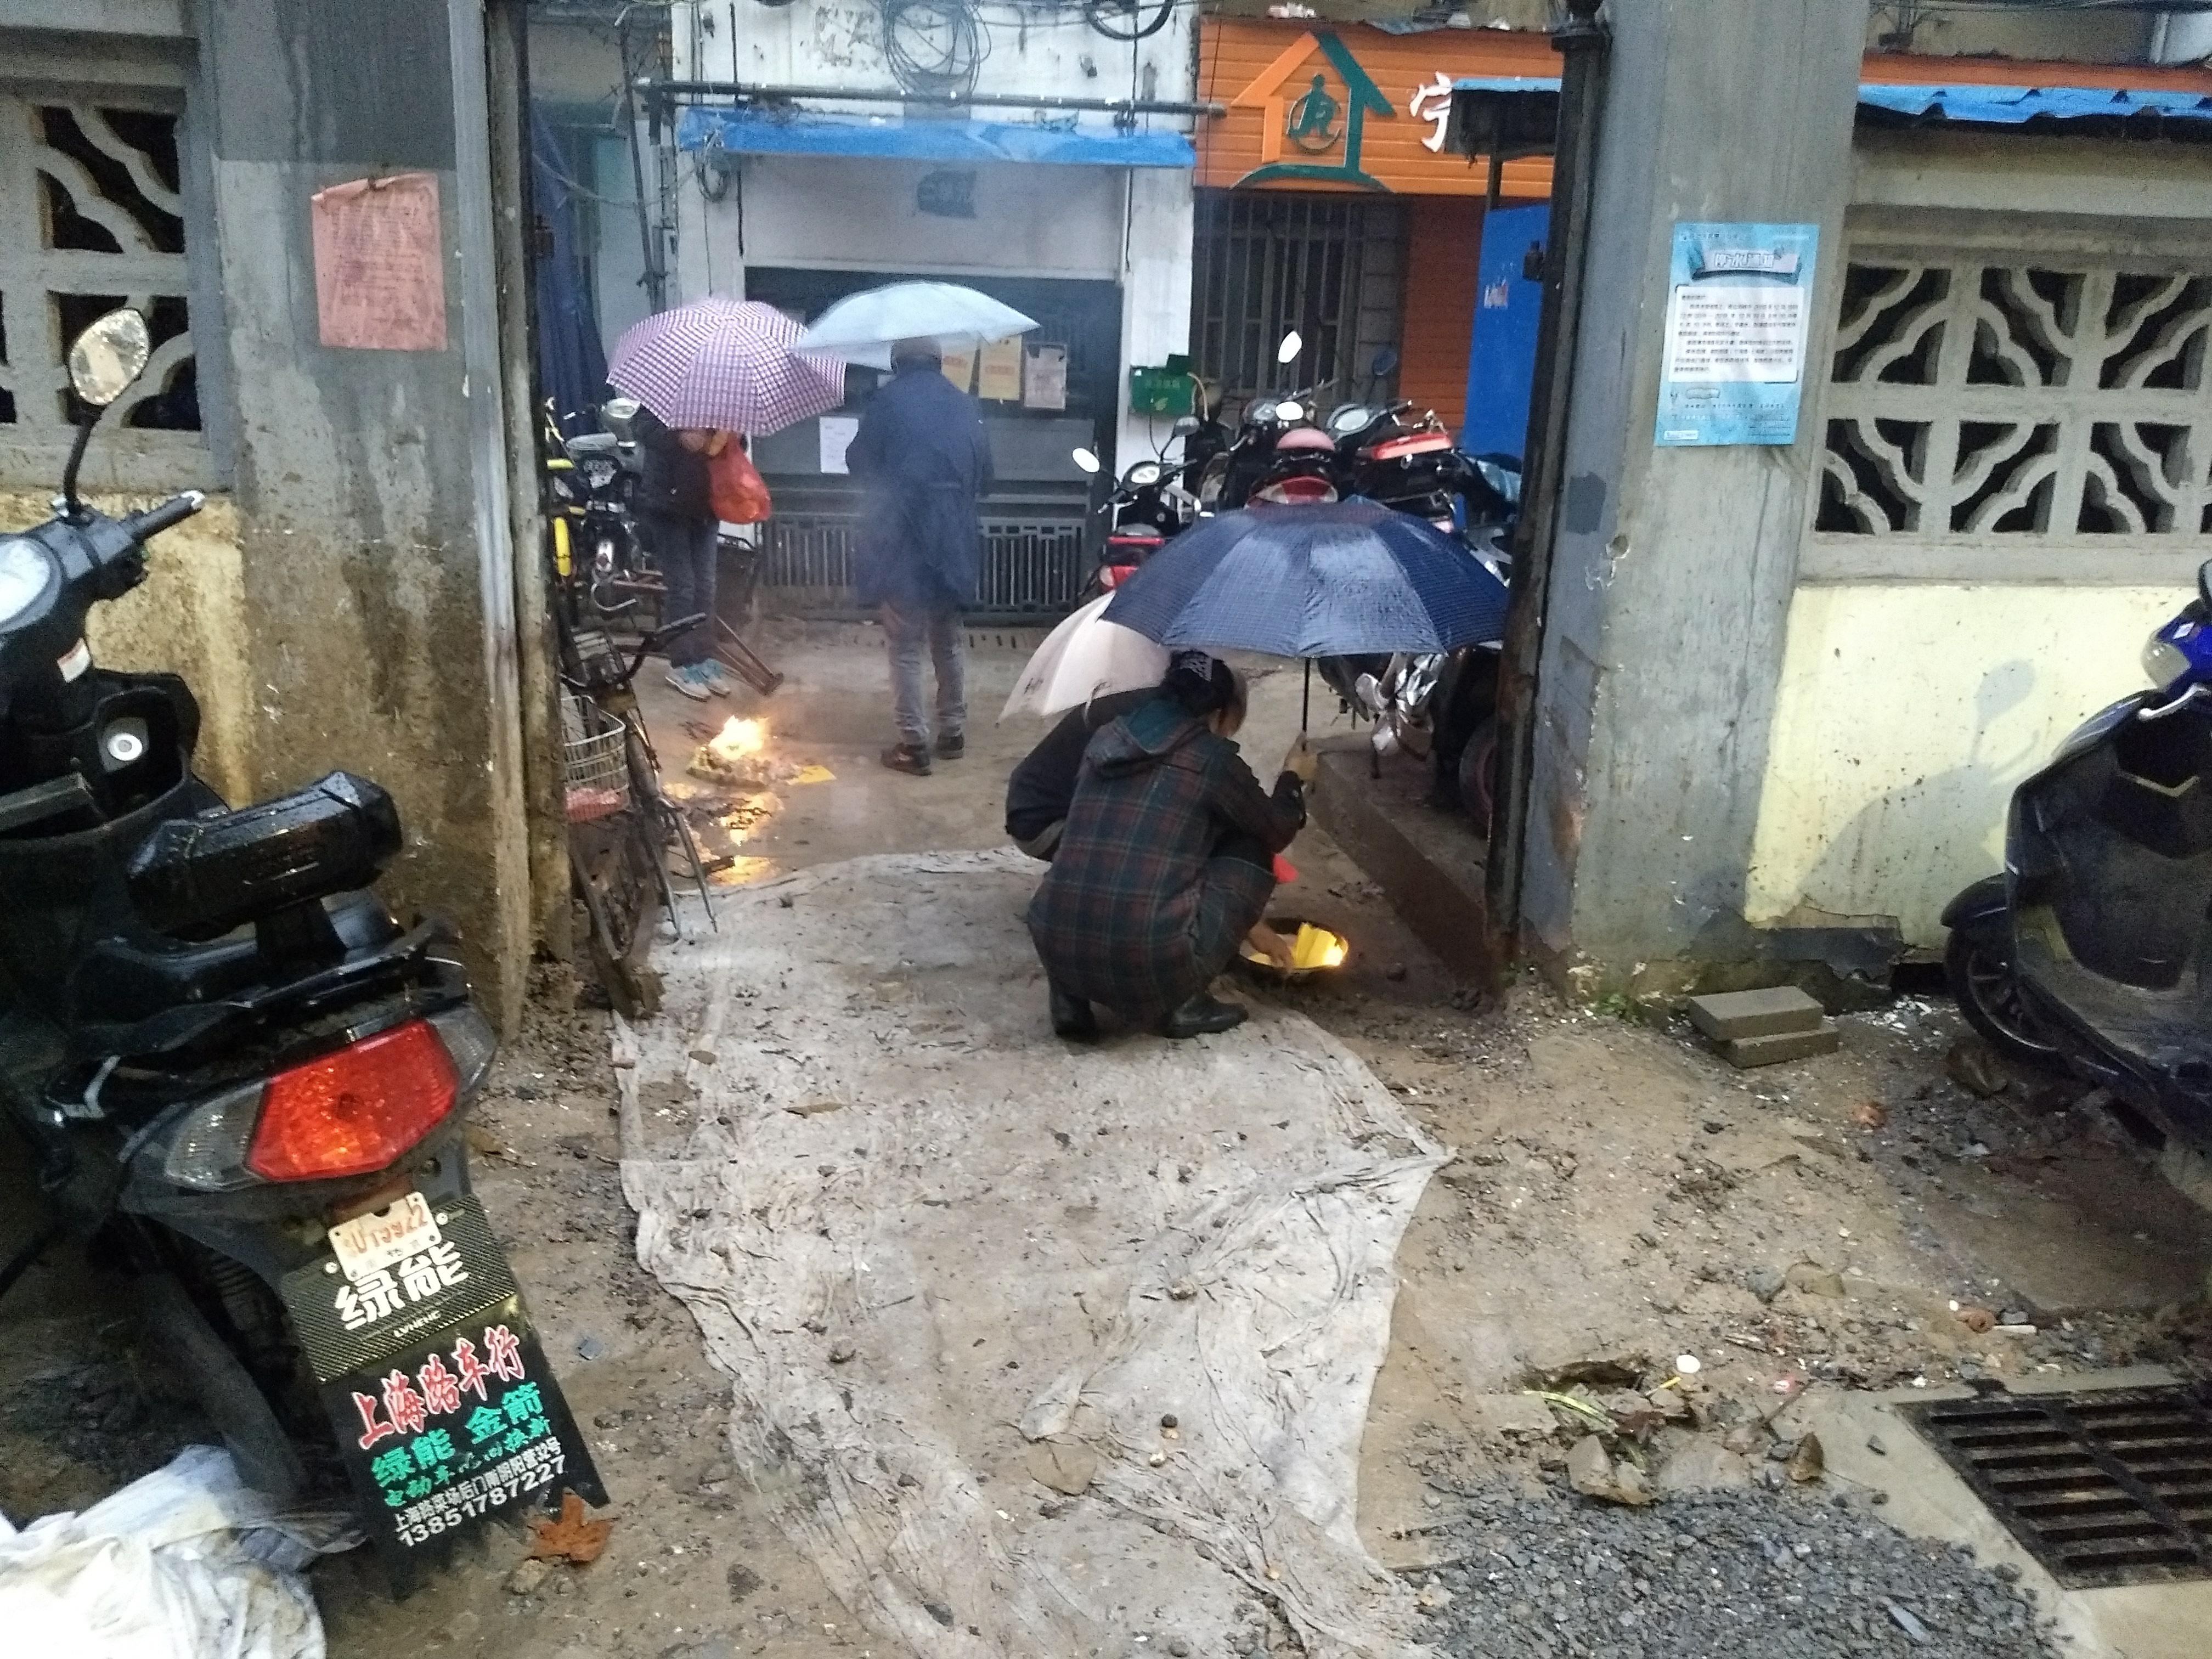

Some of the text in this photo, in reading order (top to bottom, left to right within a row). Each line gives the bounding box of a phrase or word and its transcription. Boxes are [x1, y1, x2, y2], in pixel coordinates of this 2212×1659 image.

[335, 1241, 469, 1330] 绿能
[393, 1310, 442, 1338] LVNENG
[352, 1324, 525, 1450] 上海路车行
[371, 1381, 543, 1487] 绿能 金箭
[399, 1454, 566, 1547] 13851787227
